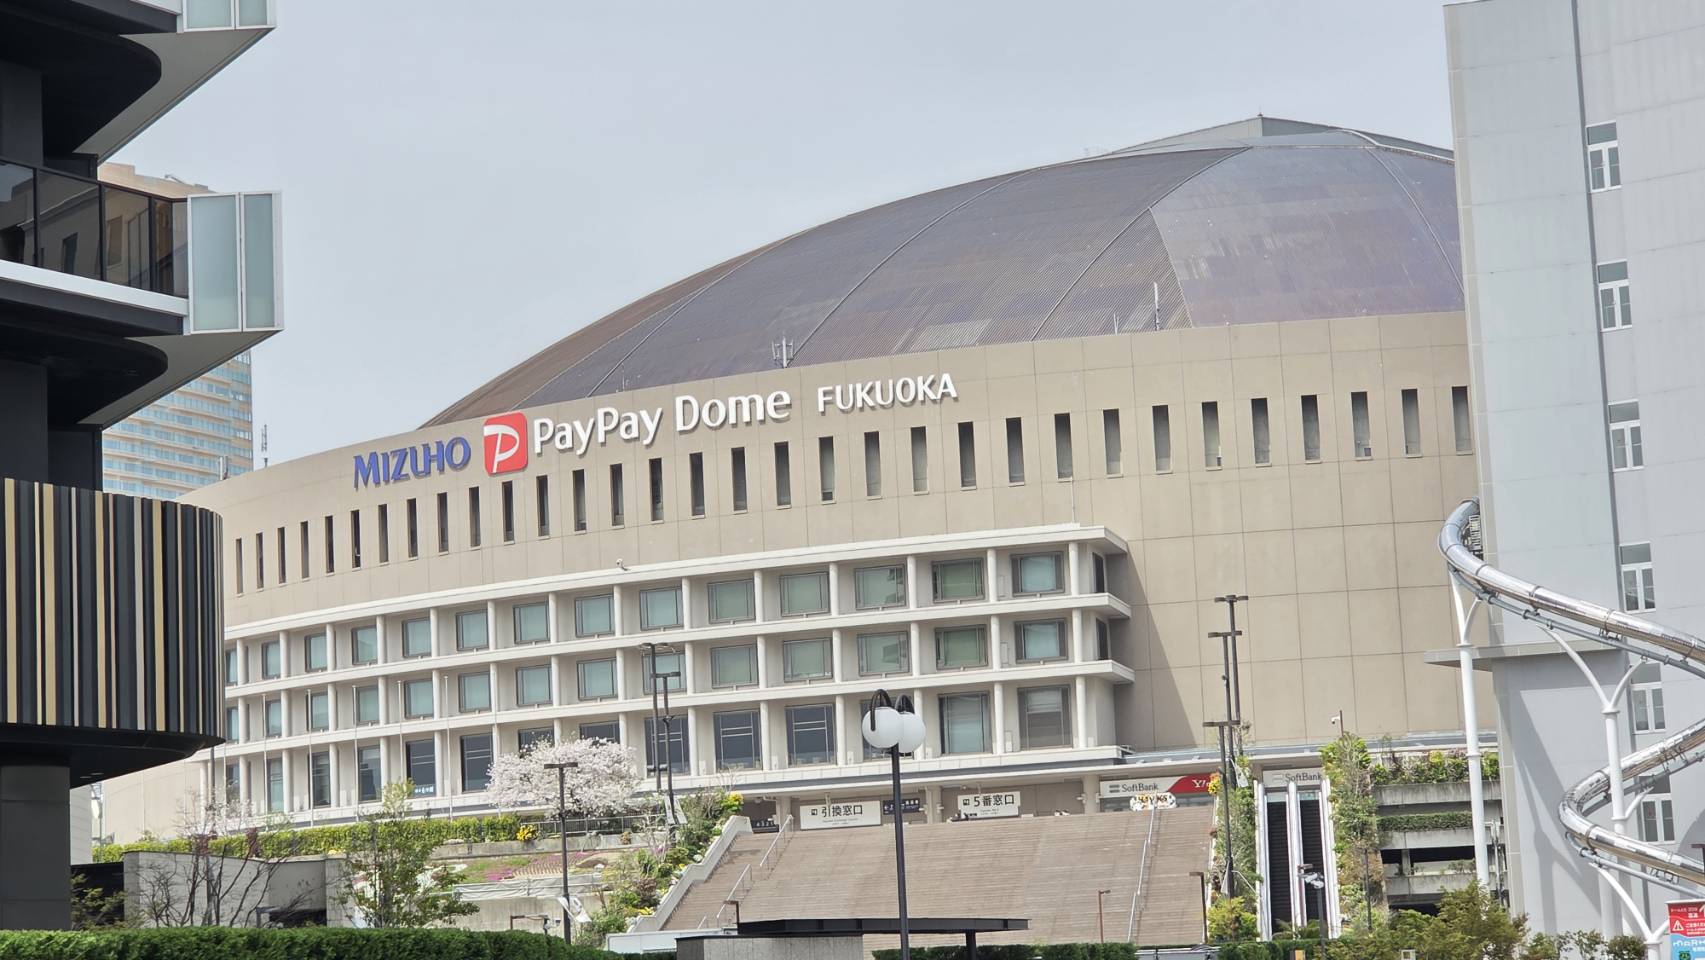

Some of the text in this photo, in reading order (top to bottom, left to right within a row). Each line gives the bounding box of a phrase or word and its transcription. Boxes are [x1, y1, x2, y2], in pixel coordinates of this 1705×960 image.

[353, 436, 471, 491] MIZUHO
[533, 406, 664, 456] PayPay
[675, 390, 792, 433] Dome
[817, 372, 958, 413] FUKUOKA
[1285, 772, 1322, 782] SoftBank
[1121, 783, 1159, 793] SoftBank
[973, 794, 1015, 807] 5番窓口
[821, 804, 863, 818] 引換窓口
